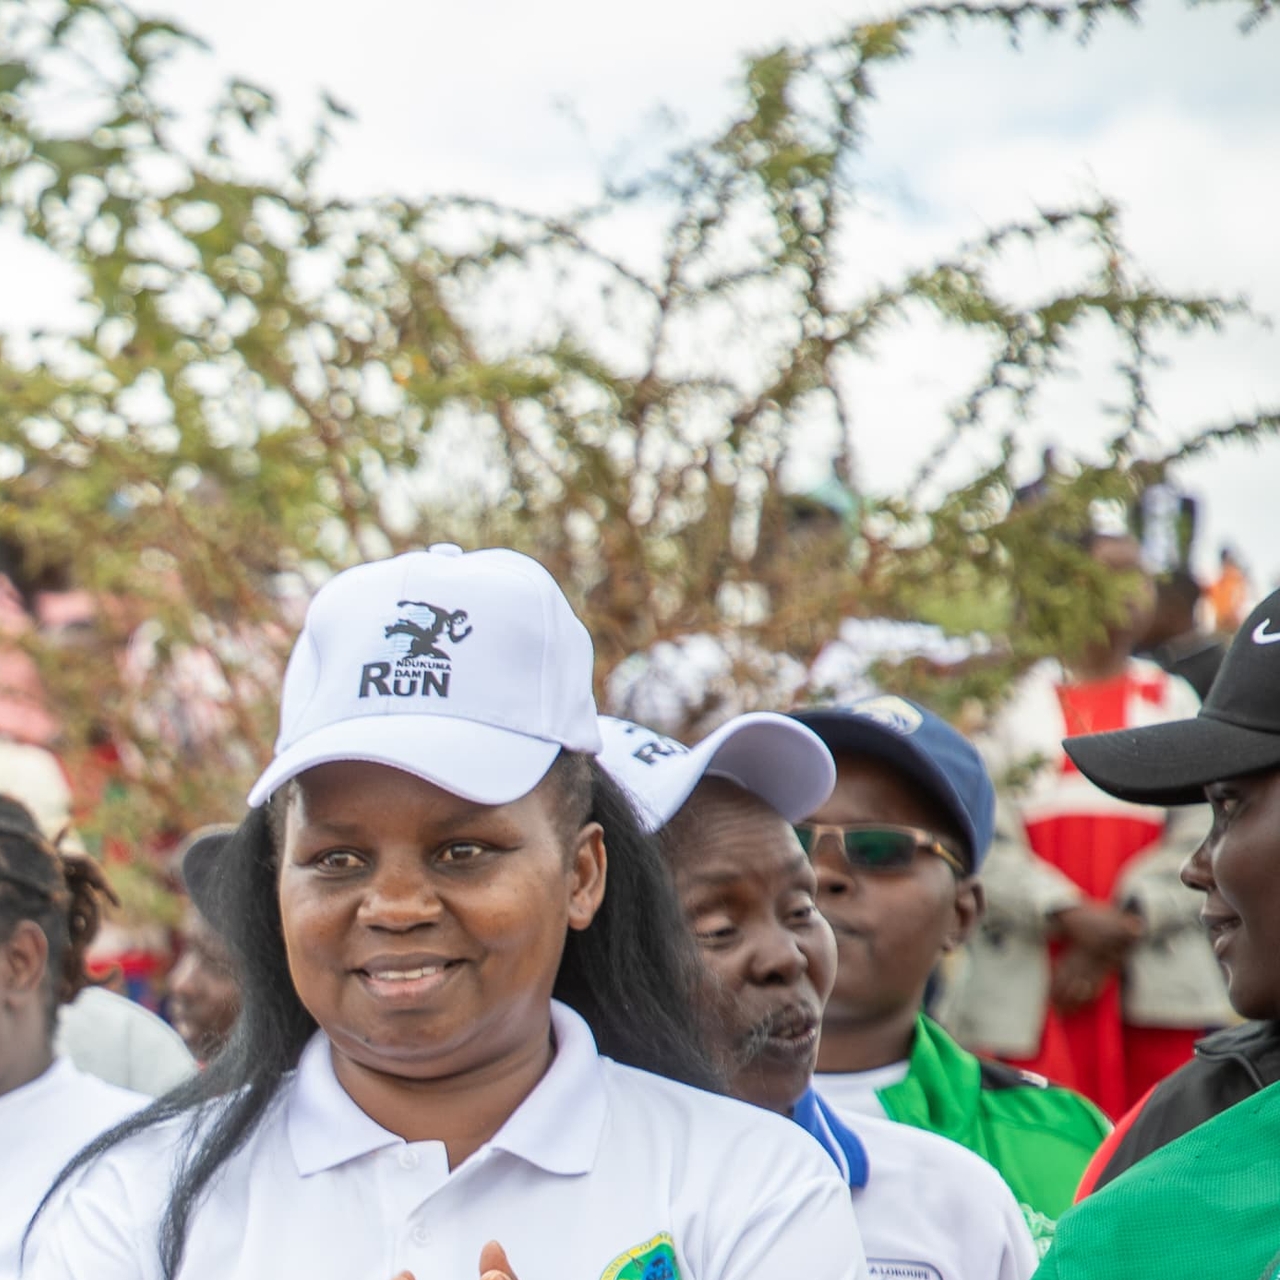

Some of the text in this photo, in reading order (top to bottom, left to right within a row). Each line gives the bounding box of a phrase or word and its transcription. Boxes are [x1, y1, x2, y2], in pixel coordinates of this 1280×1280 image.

[396, 660, 452, 671] NDUKUMA
[394, 669, 421, 678] DAM
[359, 661, 450, 698] RUN
